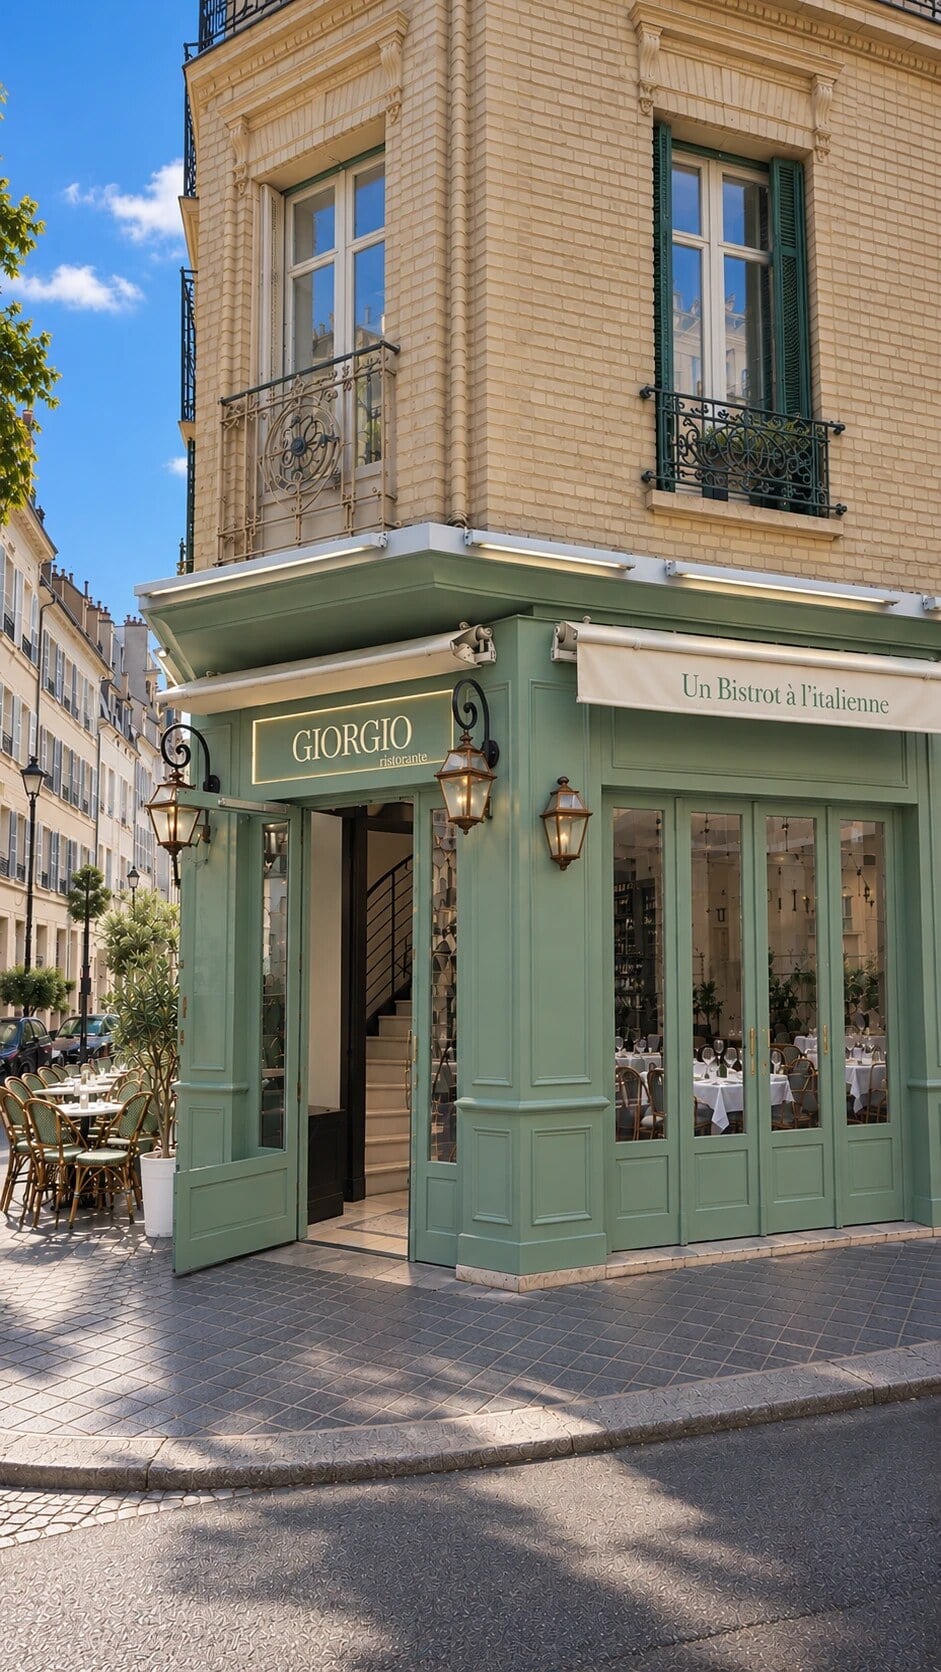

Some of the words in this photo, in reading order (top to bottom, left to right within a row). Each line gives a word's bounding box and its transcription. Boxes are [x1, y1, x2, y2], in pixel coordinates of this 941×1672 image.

[682, 673, 712, 699] Un
[717, 676, 781, 705] Bistrot
[786, 683, 797, 706] à
[801, 684, 889, 714] l'italienne
[292, 715, 412, 763] GIORGIO
[379, 752, 428, 768] ristorante
